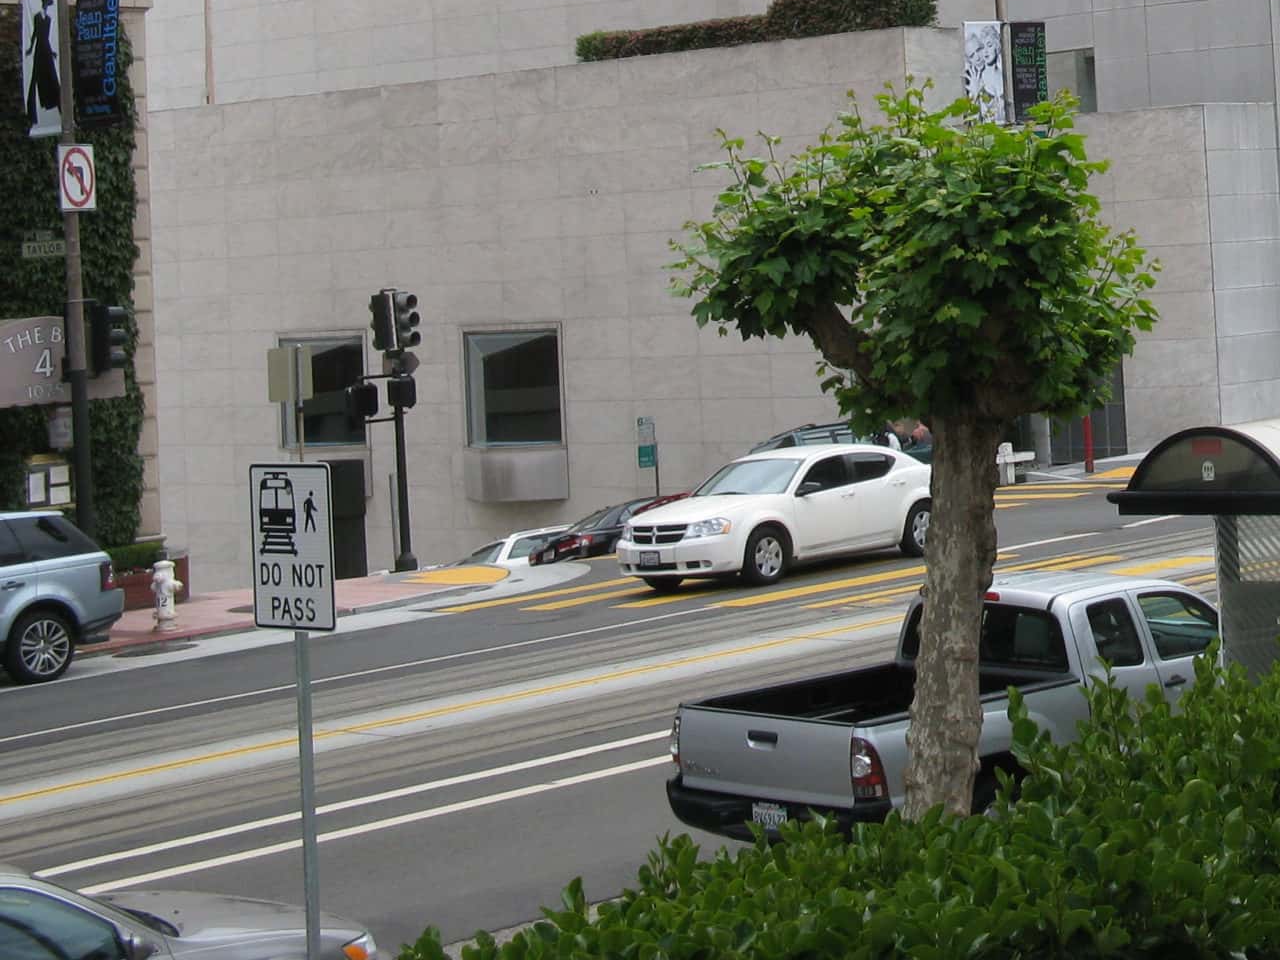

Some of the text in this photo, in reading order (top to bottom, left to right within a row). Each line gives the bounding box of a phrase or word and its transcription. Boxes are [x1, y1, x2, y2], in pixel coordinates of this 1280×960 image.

[77, 10, 102, 26] Jean
[79, 24, 102, 40] Paul
[4, 326, 65, 353] THE B
[33, 348, 54, 377] 4
[261, 562, 325, 588] DO NOT
[271, 596, 316, 622] PASS
